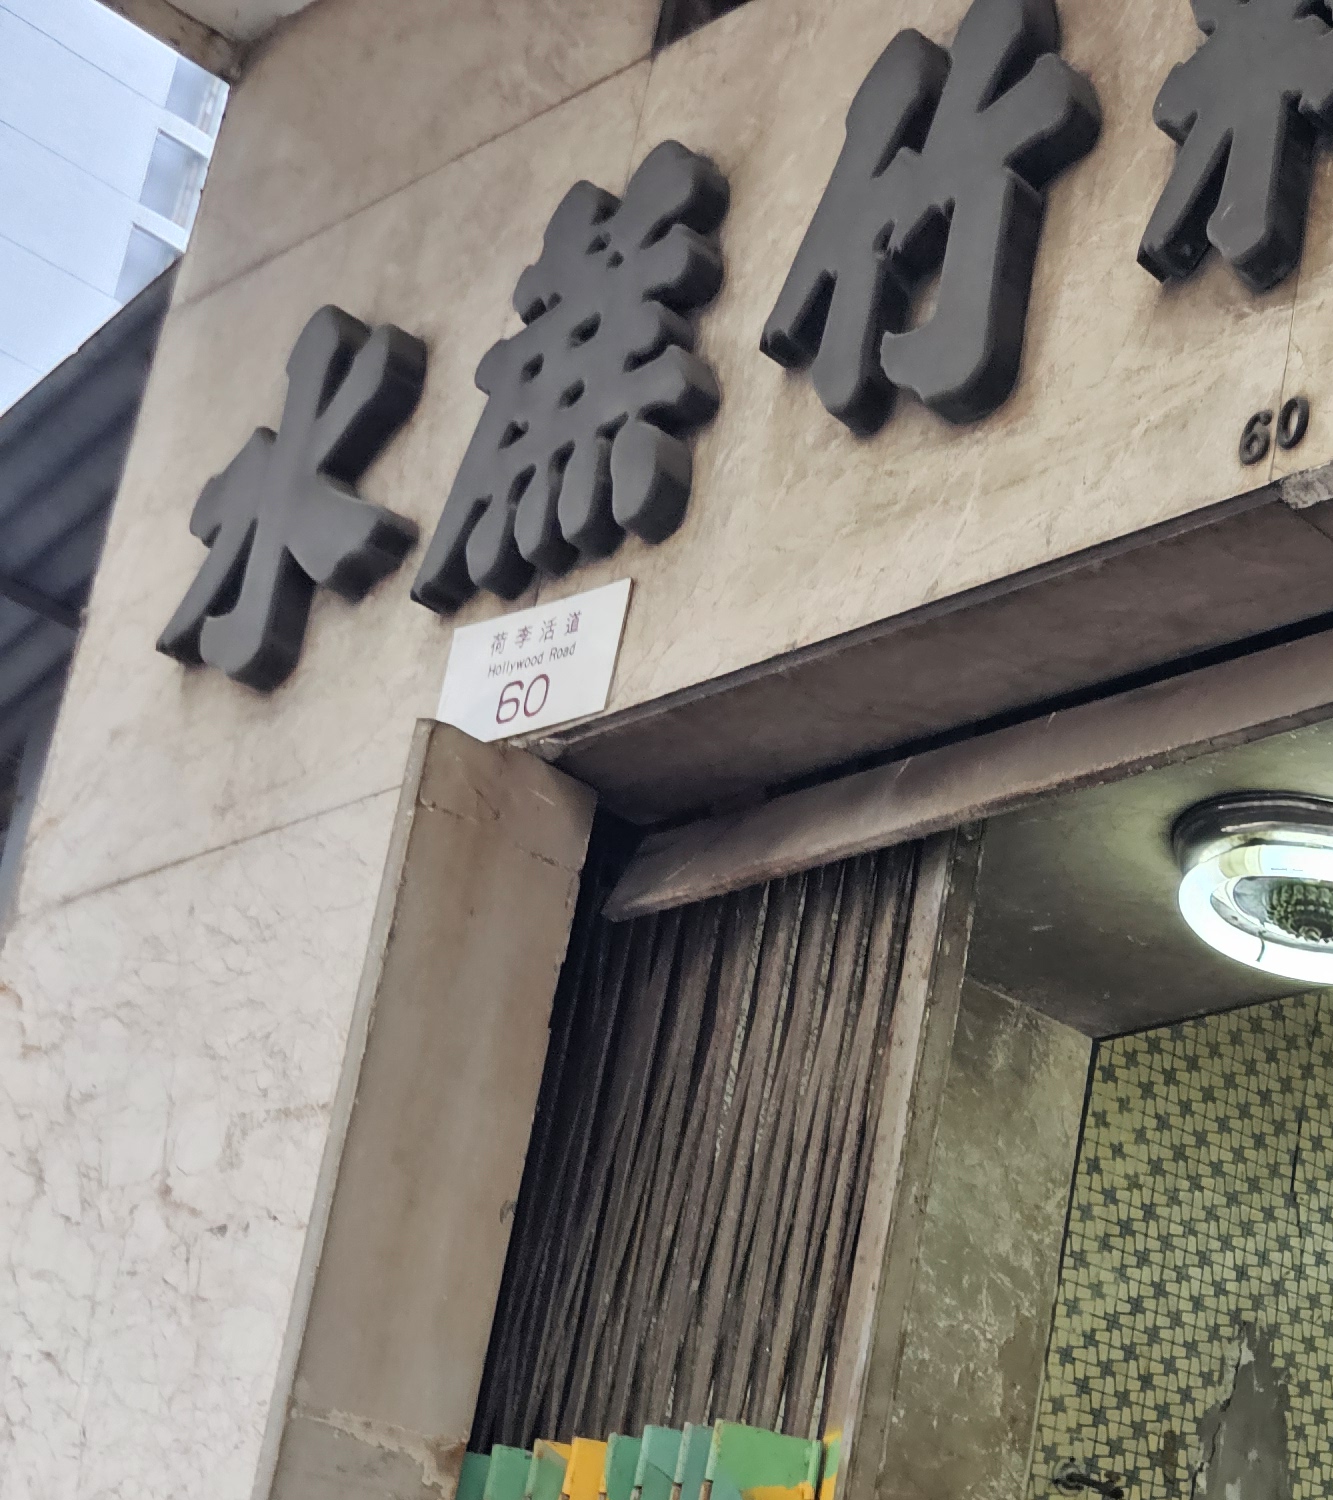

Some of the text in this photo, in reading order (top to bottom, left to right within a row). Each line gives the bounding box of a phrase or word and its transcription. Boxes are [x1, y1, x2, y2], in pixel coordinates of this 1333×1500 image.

[1238, 395, 1310, 467] 60
[490, 610, 582, 657] 荷李活道
[487, 641, 576, 678] Hollywood Road
[496, 673, 550, 724] 60
